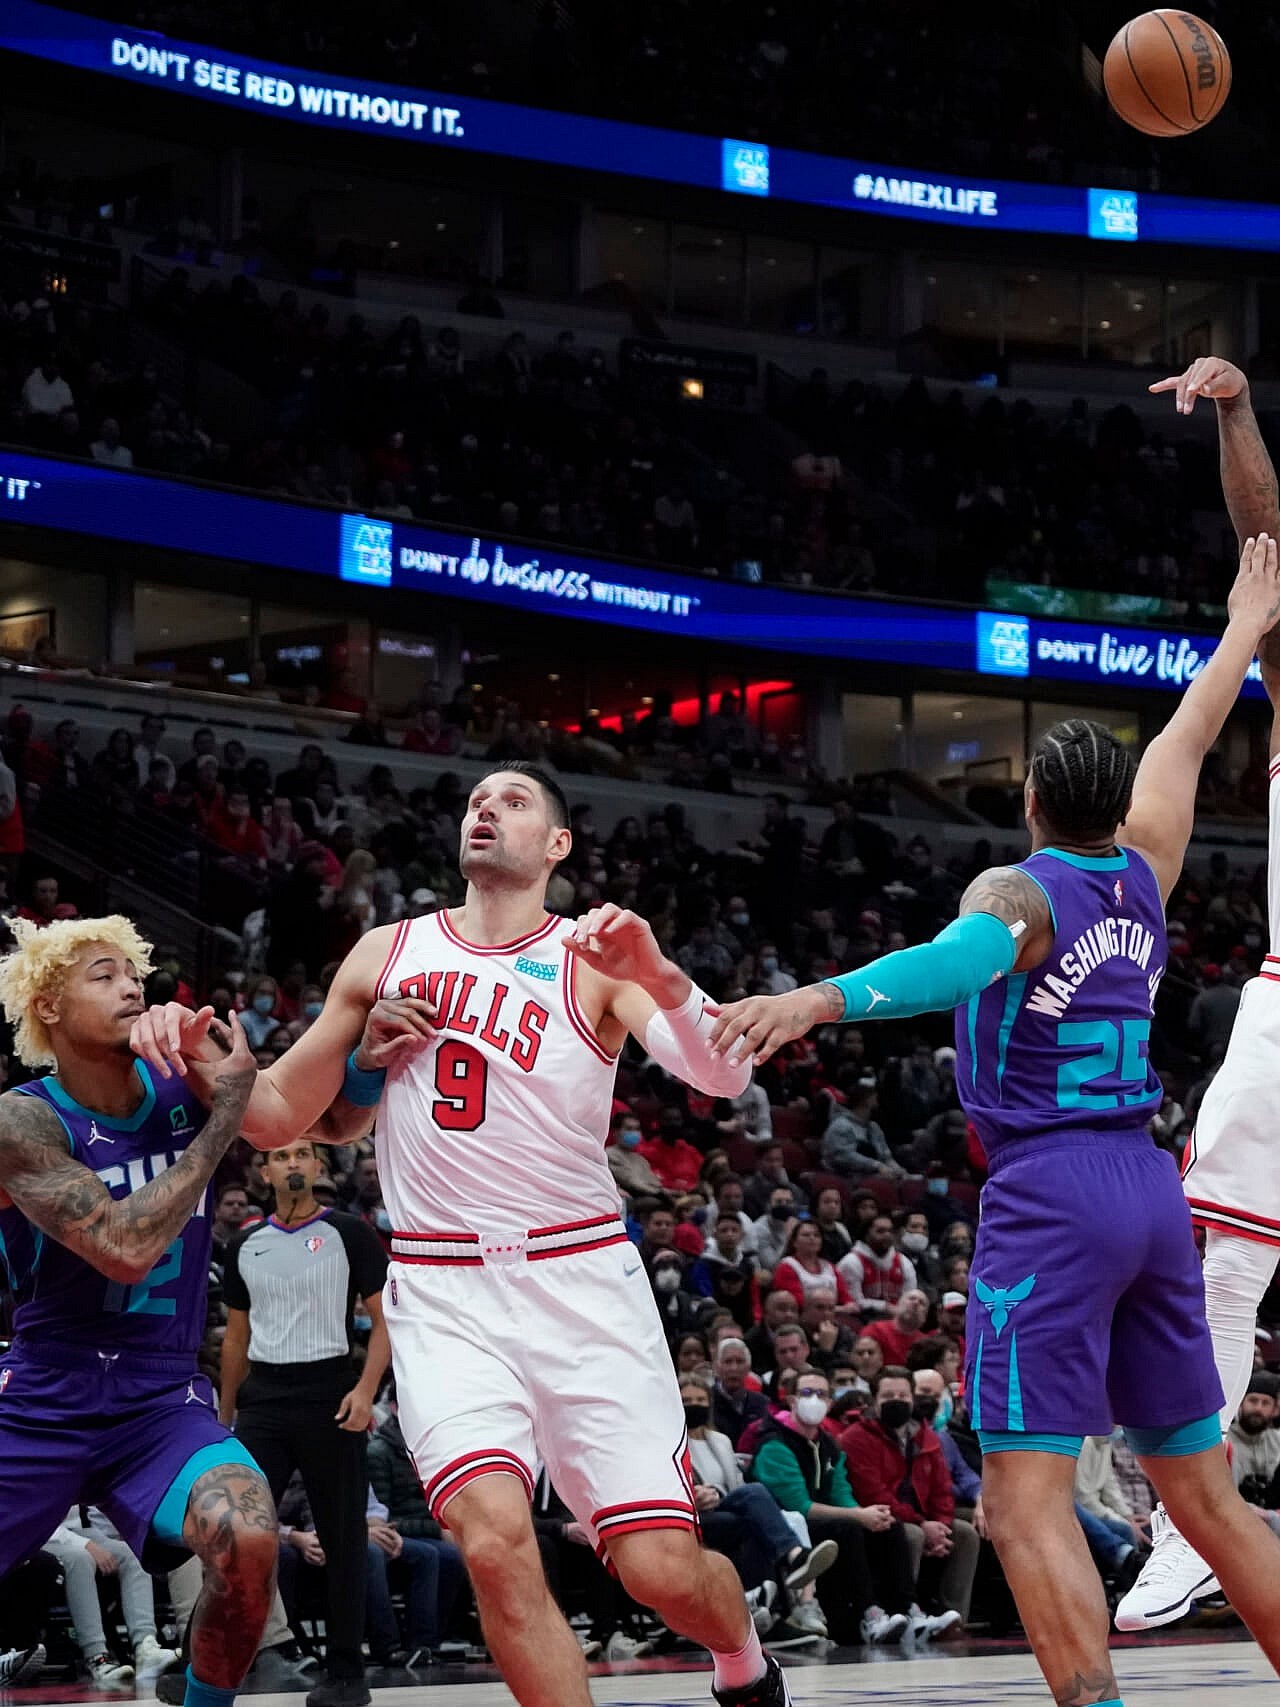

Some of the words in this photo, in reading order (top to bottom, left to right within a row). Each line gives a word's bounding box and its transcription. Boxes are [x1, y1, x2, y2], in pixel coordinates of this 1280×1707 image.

[111, 38, 190, 81] DON'T
[194, 59, 240, 95] SEE
[245, 72, 295, 106] RED
[299, 84, 428, 130] WITHOUT
[432, 107, 464, 137] IT.
[853, 174, 998, 216] #AMEXLIFE
[400, 547, 460, 577] DON'T
[460, 538, 490, 584] do
[492, 545, 591, 600] business
[591, 580, 671, 614] WITHOUT
[1037, 637, 1096, 664] DON'T
[1098, 632, 1154, 676] live
[1157, 638, 1204, 685] life
[1025, 917, 1155, 1018] WASHINGTON
[432, 1038, 489, 1132] 9
